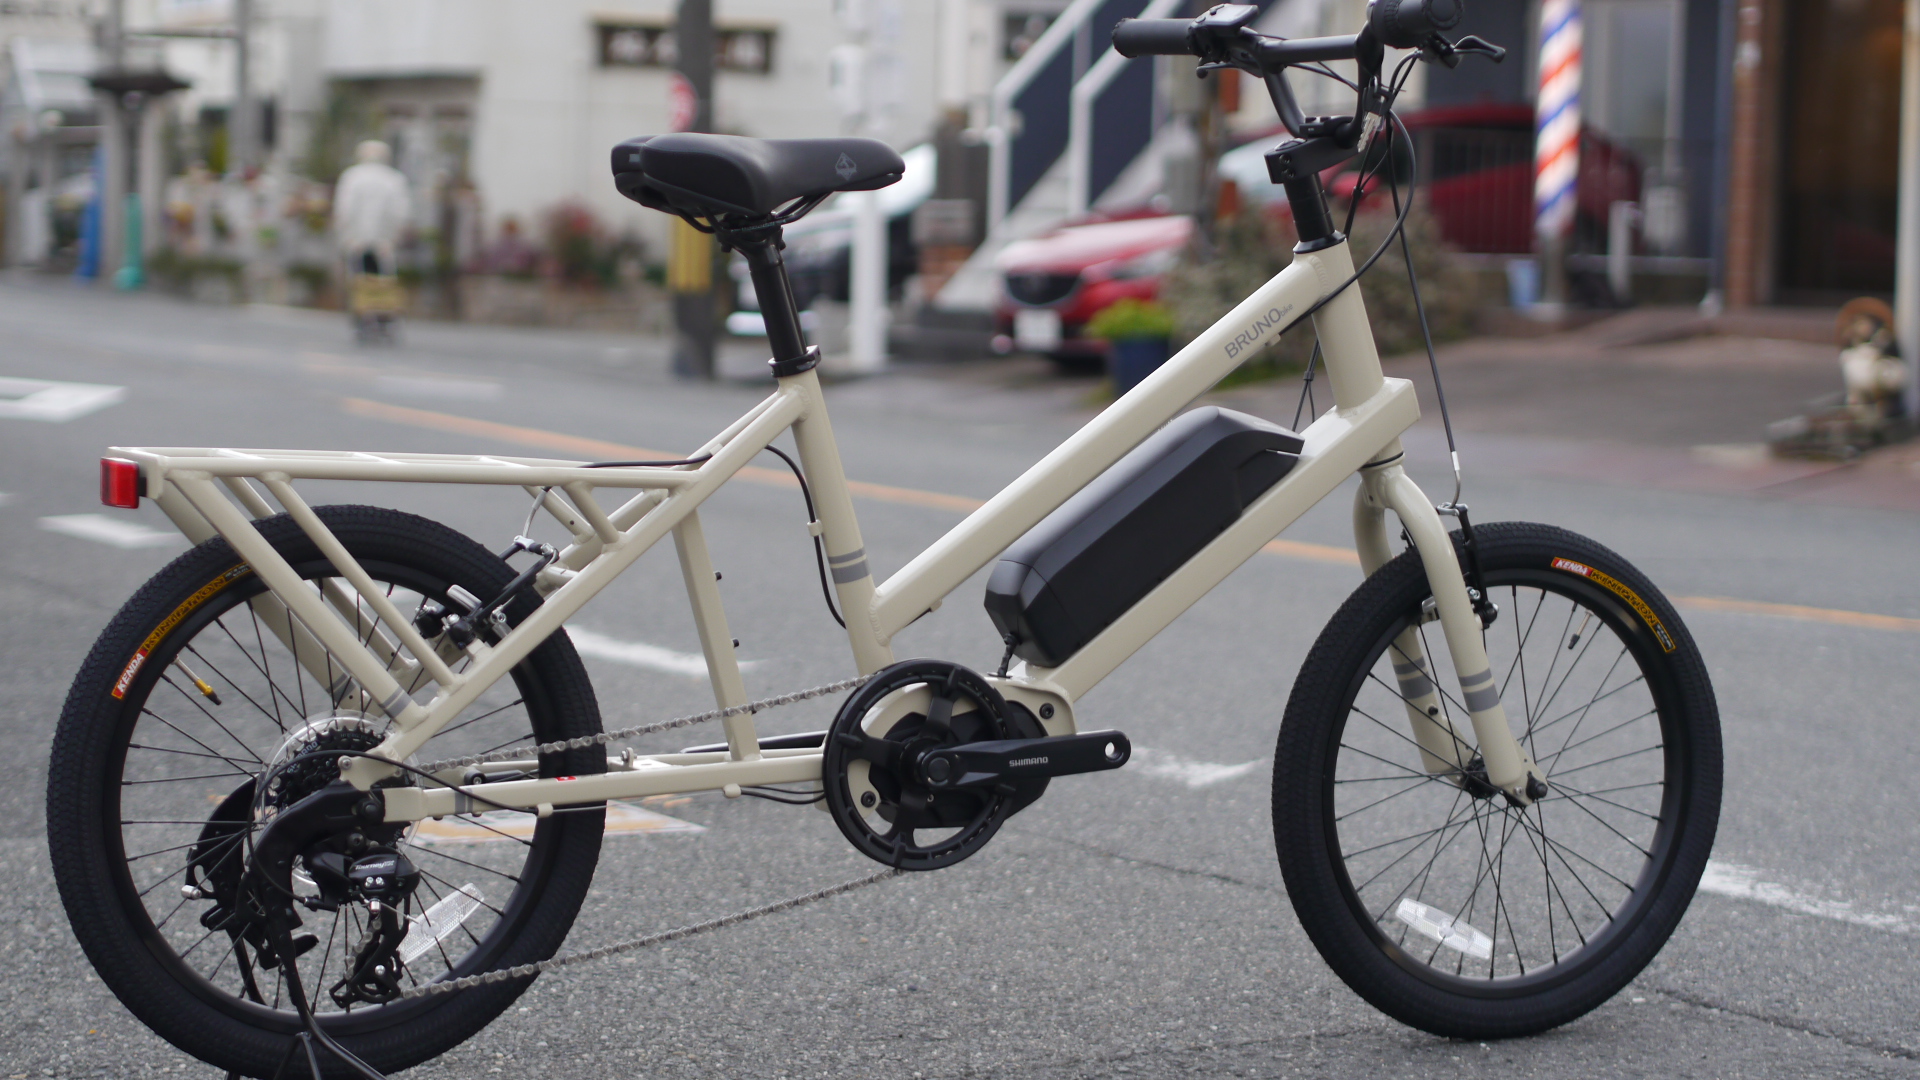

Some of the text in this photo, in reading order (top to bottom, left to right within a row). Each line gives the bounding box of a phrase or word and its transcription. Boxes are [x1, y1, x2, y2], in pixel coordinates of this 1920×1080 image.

[1224, 303, 1294, 359] BRUNO bike
[1555, 559, 1588, 575] KENDA
[117, 652, 144, 693] KENDA
[286, 741, 318, 774] SHANO
[1009, 756, 1049, 767] SHIMANO
